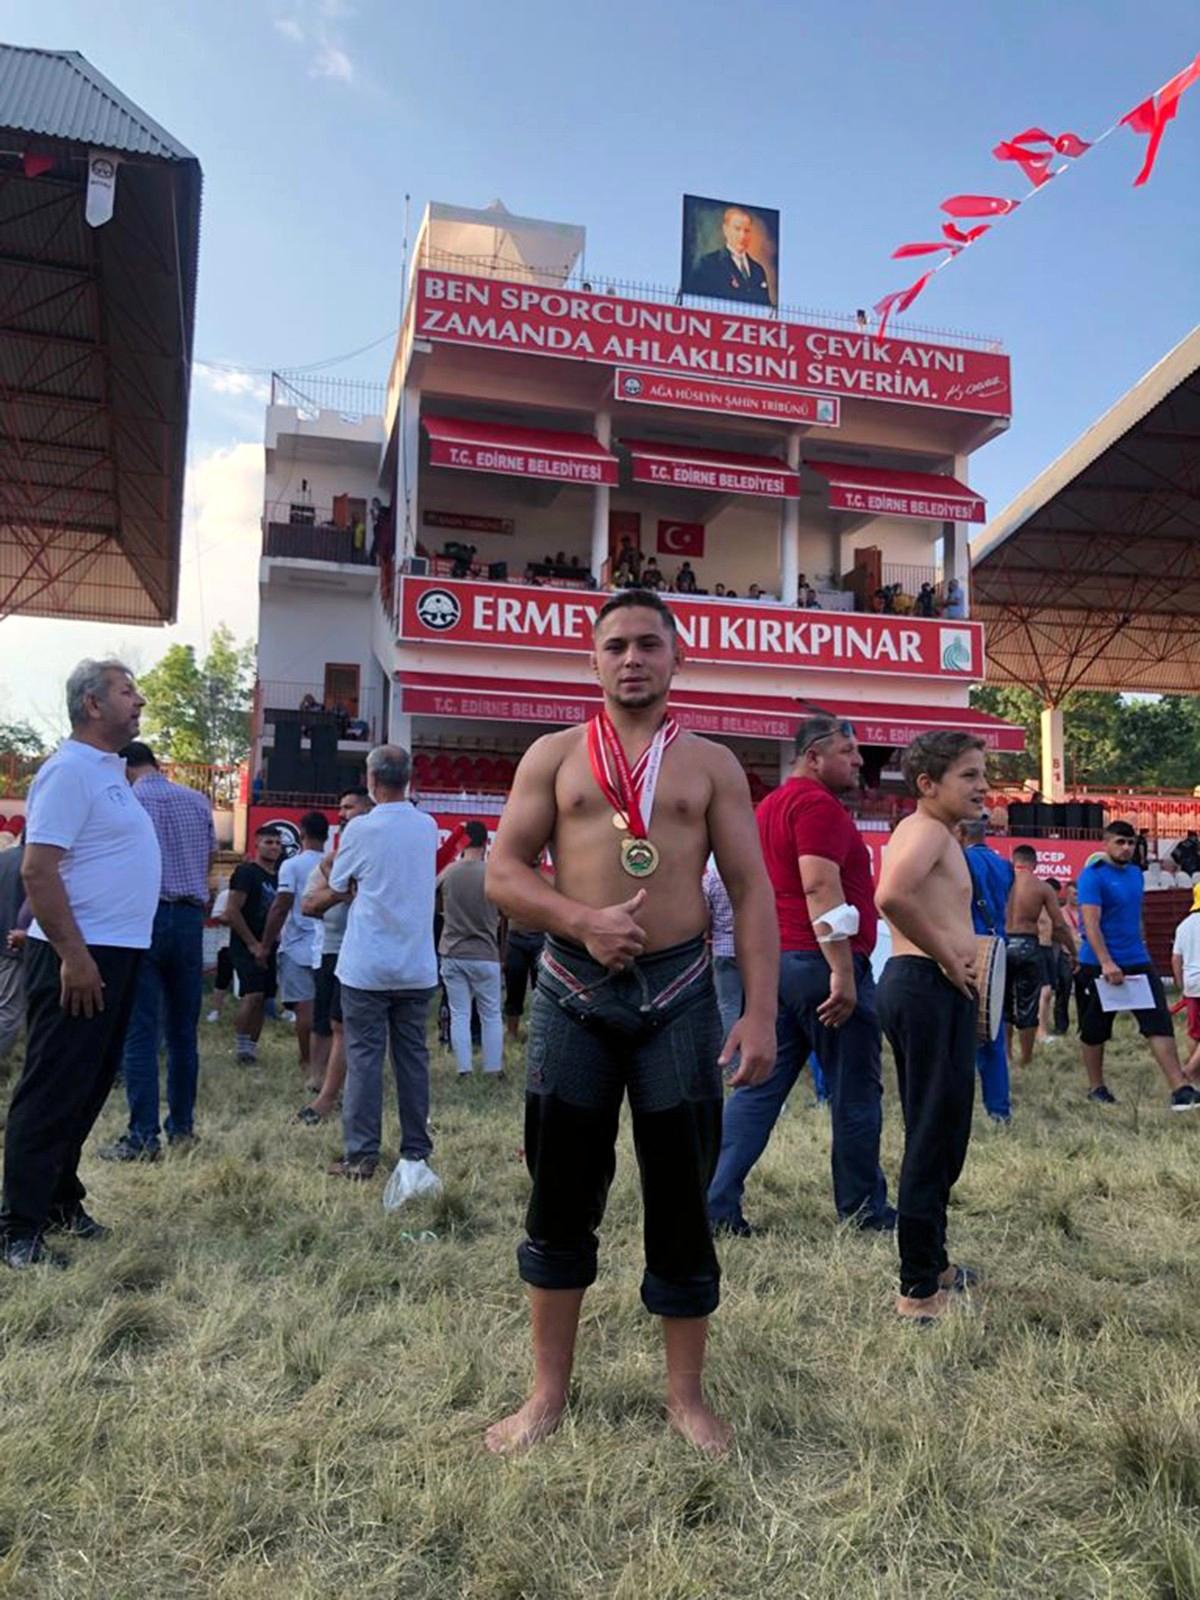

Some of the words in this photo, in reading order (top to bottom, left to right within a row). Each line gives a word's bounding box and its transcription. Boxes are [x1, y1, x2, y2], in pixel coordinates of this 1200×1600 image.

[425, 277, 490, 305] BEN
[501, 288, 711, 338] SPORCUNUN
[721, 320, 796, 354] ZEKİ,
[806, 333, 892, 363] ÇEVİK
[898, 347, 964, 373] AYNI
[422, 309, 594, 353] ZAMANDA
[603, 336, 797, 380] AHLAKLISINI
[807, 363, 938, 399] SEVERİM.
[650, 384, 673, 398] AĞA
[449, 449, 473, 465] T.C.
[476, 451, 525, 472] EDİRNE
[528, 458, 602, 481] BELEDİYESİ
[650, 465, 671, 480] T.C.
[673, 467, 717, 486] EDİRNE
[719, 473, 785, 493] BELEDİYESİ
[845, 493, 865, 508] T.C.
[868, 494, 908, 513] EDİRNE
[910, 500, 973, 519] BELEDİYESİ
[473, 595, 710, 649] ERMENI
[720, 616, 924, 663] KIRKPINAR
[434, 697, 457, 713] T.C.
[461, 698, 509, 716] EDİRNE
[512, 702, 586, 721] BELEDİYESİ
[866, 726, 887, 741] T.C.
[1033, 864, 1072, 875] RKAN
[1036, 851, 1065, 862] ECEP
